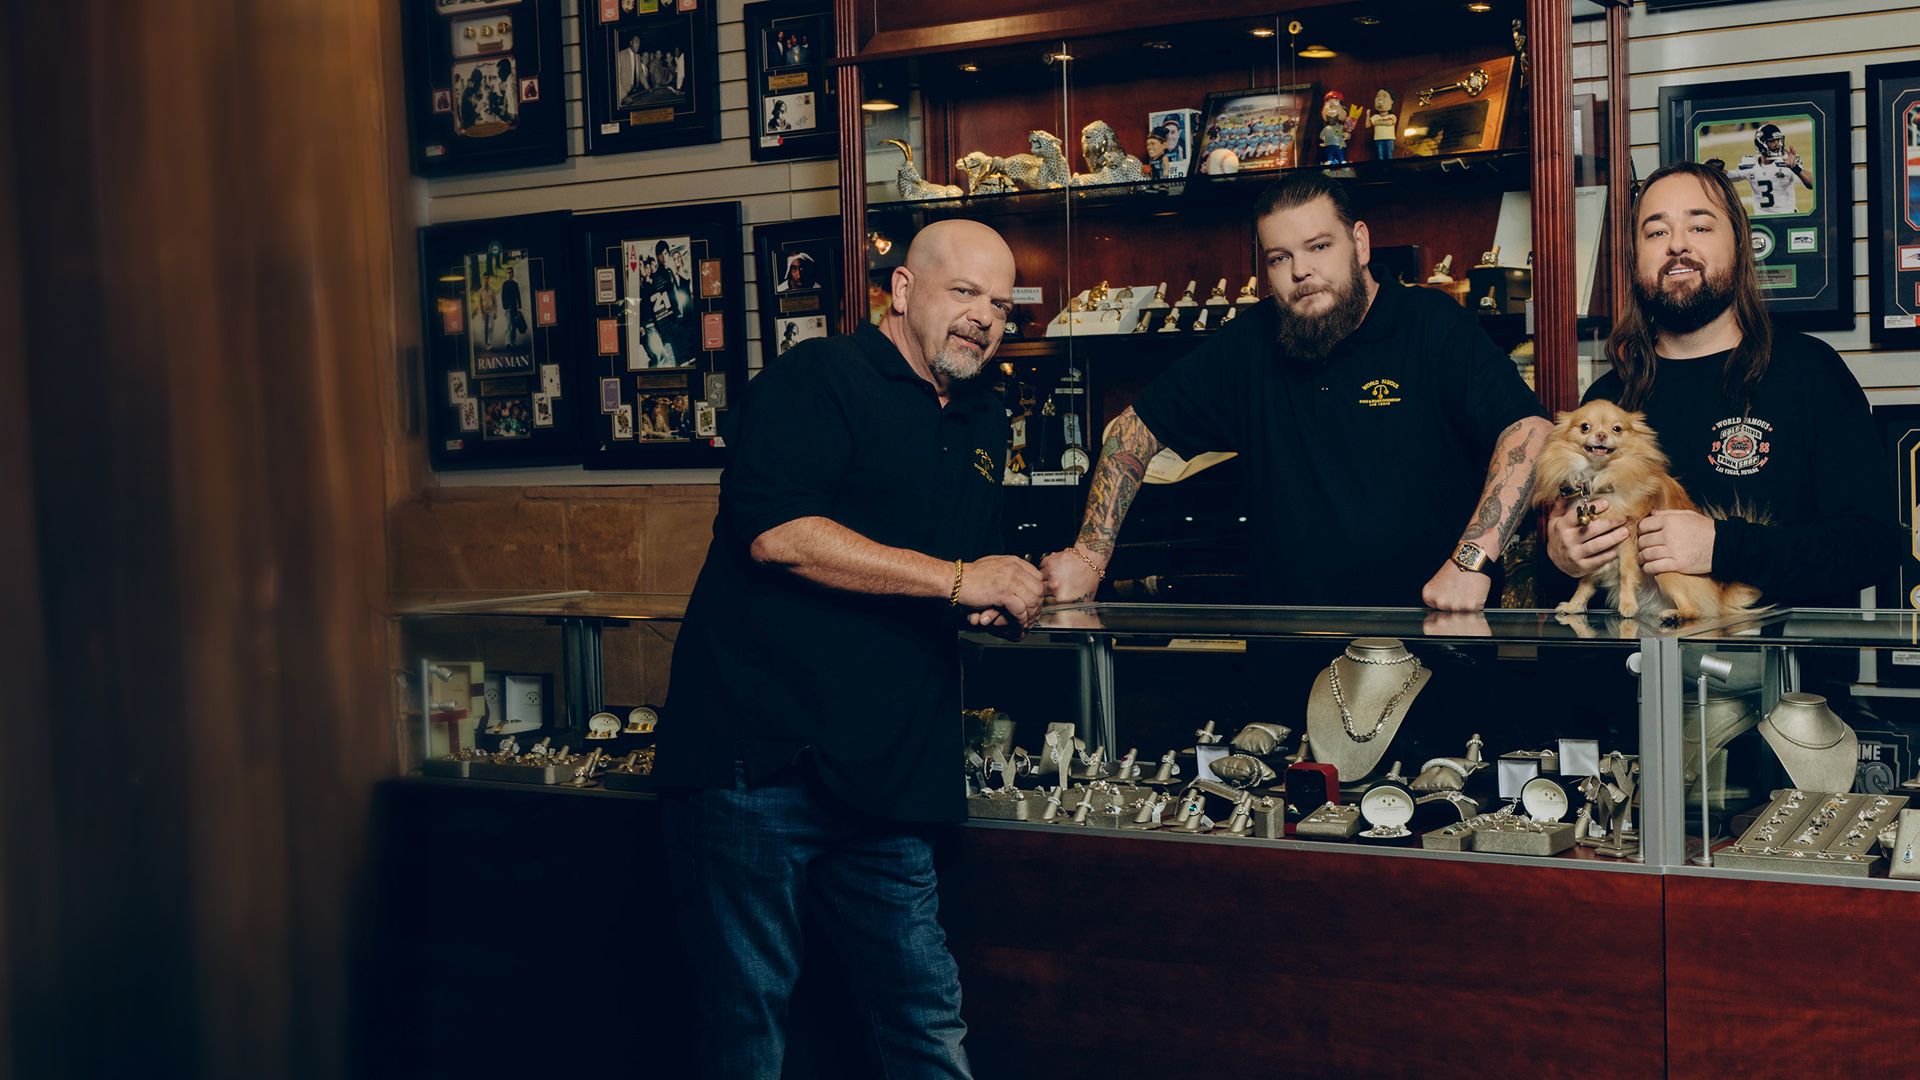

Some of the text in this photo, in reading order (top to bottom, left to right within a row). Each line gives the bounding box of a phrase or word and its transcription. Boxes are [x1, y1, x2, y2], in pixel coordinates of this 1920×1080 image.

[1758, 180, 1775, 208] 3
[649, 290, 673, 313] 21
[478, 354, 529, 369] RAIN MAN
[1715, 417, 1771, 430] WORLD FAMOUS
[1742, 426, 1761, 438] SILVER
[1712, 441, 1770, 453] 19 88
[1719, 456, 1758, 468] PAWN SHOP
[1715, 465, 1724, 473] LAS
